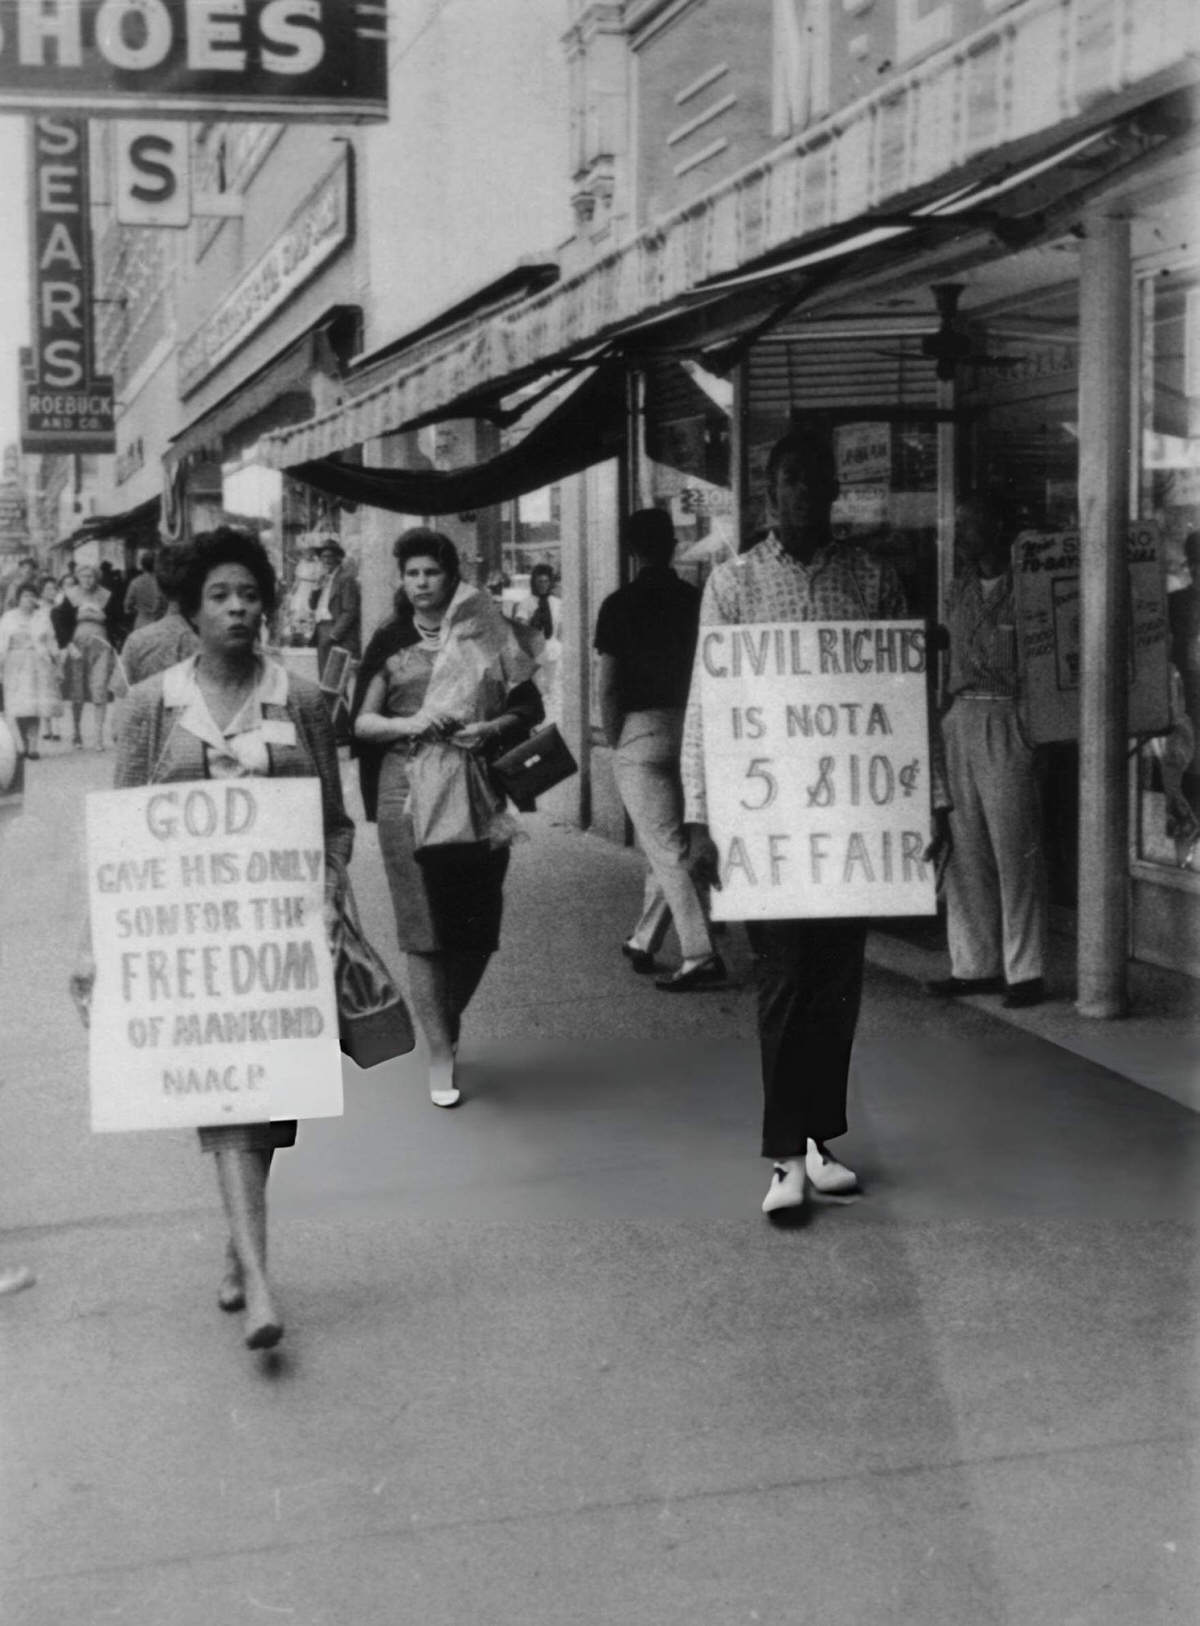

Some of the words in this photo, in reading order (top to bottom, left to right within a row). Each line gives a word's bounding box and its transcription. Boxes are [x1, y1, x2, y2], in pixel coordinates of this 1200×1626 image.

[0, 0, 325, 74] HOES
[39, 115, 82, 387] SEARS
[29, 395, 112, 415] ROEBUCK
[41, 417, 73, 430] AND
[703, 630, 811, 677] CIVIL
[818, 629, 925, 674] RIGHTS
[732, 708, 765, 739] IS
[787, 704, 861, 737] NOT
[866, 704, 892, 735] A
[741, 759, 777, 810] 5
[807, 757, 835, 807] &
[147, 788, 256, 841] GOD
[97, 859, 165, 893] GAVE
[181, 853, 238, 886] HIS
[247, 851, 322, 884] ONLY
[723, 832, 928, 886] AFFAIR
[117, 904, 178, 938] SON
[186, 901, 242, 934] FOR
[250, 898, 304, 931] THE
[122, 942, 318, 1002] FREEDOM
[129, 1017, 164, 1048] OF
[173, 1007, 323, 1046] MANKIND
[164, 1065, 265, 1095] NAACP
